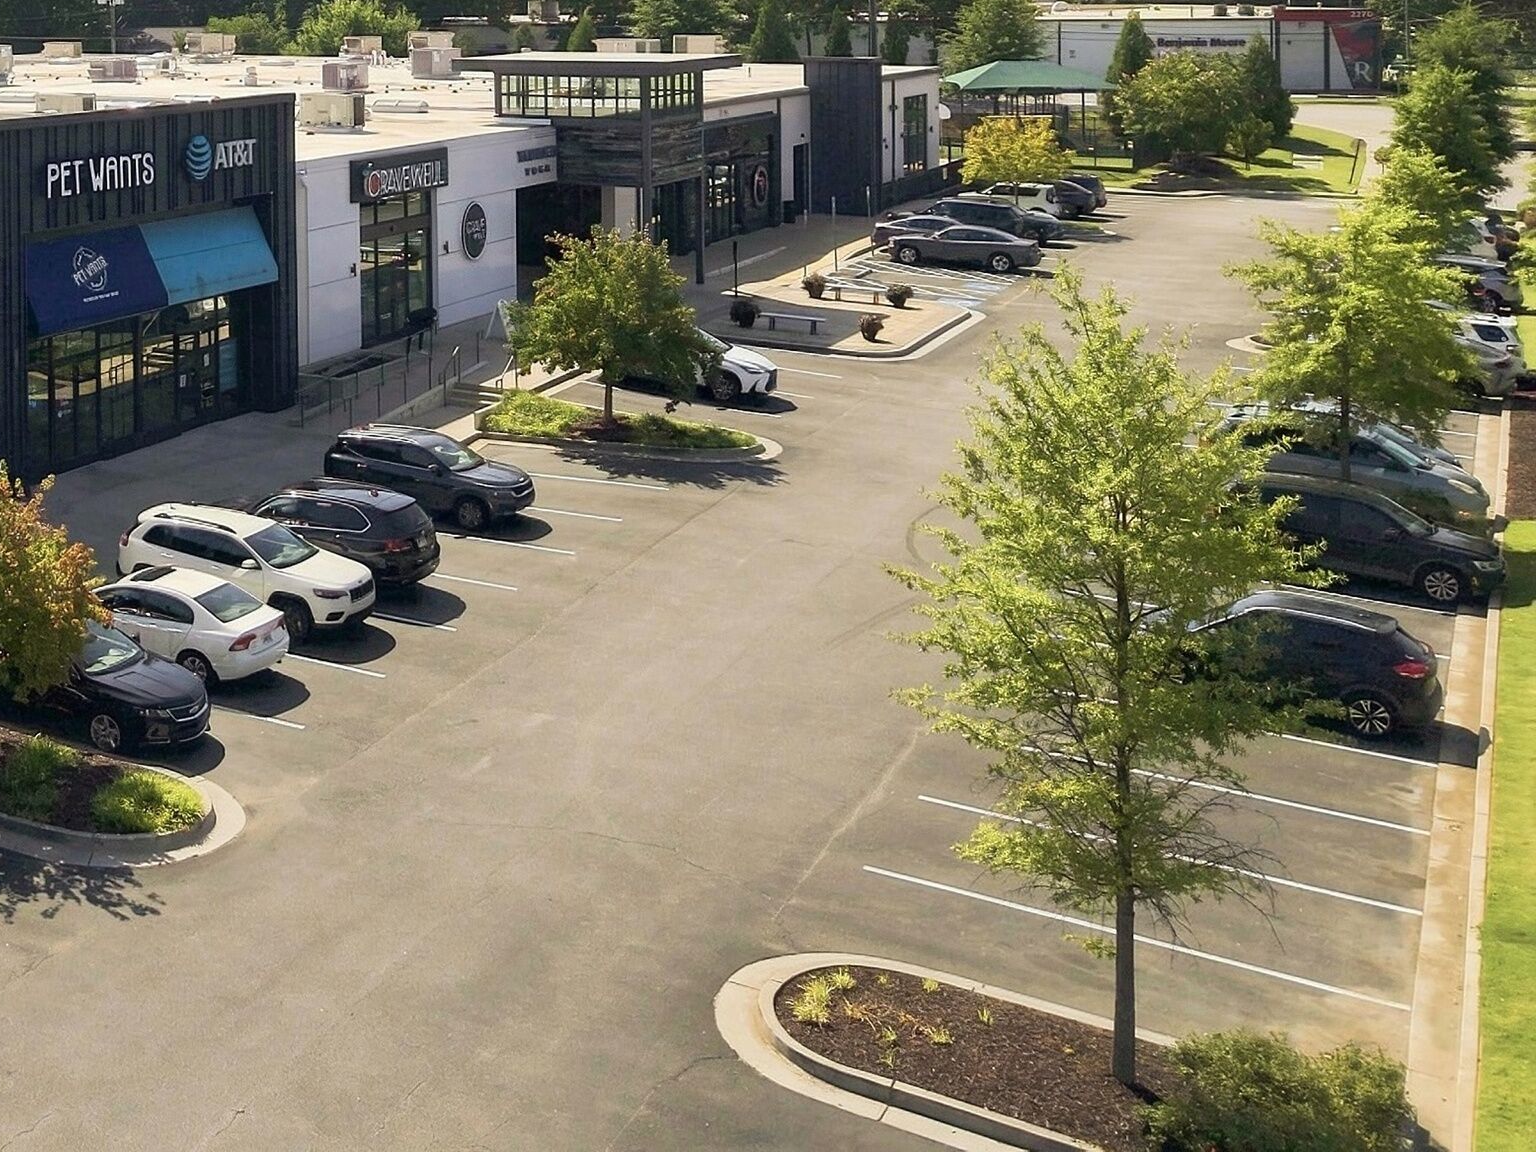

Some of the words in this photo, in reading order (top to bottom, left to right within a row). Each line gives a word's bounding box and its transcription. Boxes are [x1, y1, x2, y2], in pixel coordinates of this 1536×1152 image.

[1350, 10, 1373, 18] 2270
[214, 138, 257, 170] AT&T
[47, 160, 84, 199] PET
[89, 152, 155, 191] WANTS
